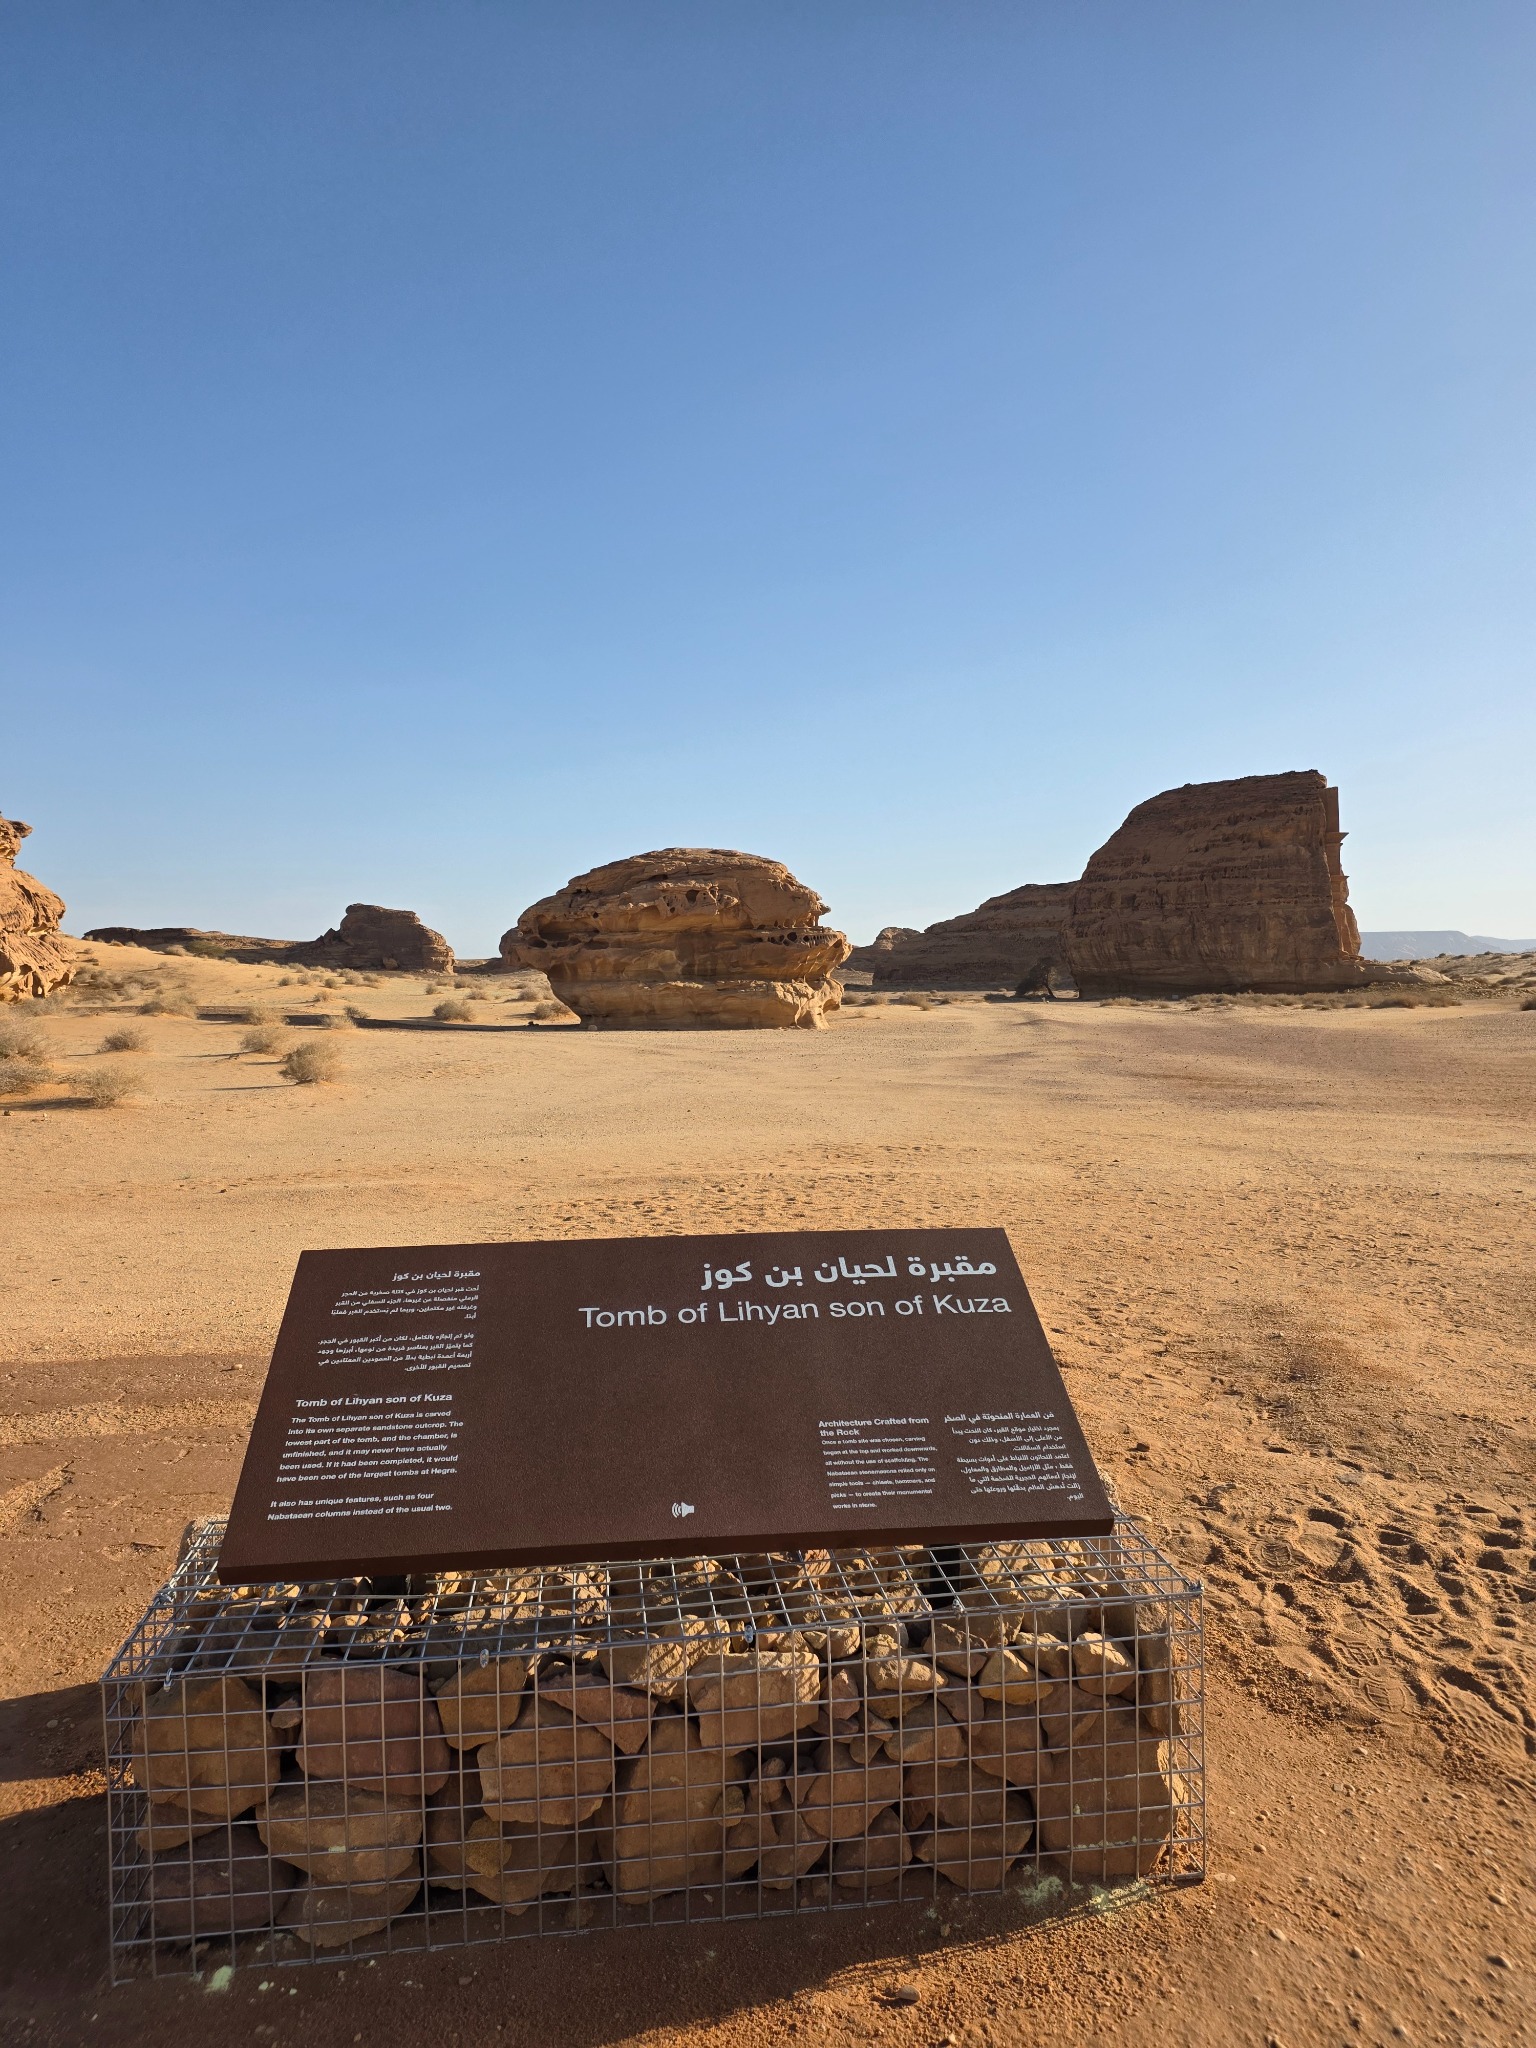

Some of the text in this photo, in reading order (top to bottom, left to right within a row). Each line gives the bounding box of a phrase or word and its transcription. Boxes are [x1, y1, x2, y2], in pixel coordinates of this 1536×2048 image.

[392, 1270, 481, 1281] مقبرة لحيان بن كوز
[701, 1255, 997, 1290] مقبرة لحيان بن كوز
[578, 1294, 1012, 1328] Tomb of Lihyan son of Kuza
[296, 1398, 327, 1407] Tomb
[330, 1397, 343, 1406] of
[345, 1397, 383, 1406] Lihyan
[409, 1394, 422, 1402] of
[424, 1393, 452, 1401] Kuza
[819, 1419, 872, 1427] Architecture
[874, 1417, 907, 1425] Crafted
[944, 1411, 1054, 1424] فن العمارة المنحوتة في الصخر
[336, 1425, 371, 1433] separate
[836, 1428, 860, 1436] Rock
[314, 1438, 330, 1446] part
[363, 1470, 392, 1478] largest
[315, 1510, 351, 1518] columns
[352, 1507, 384, 1515] instead
[411, 1504, 434, 1512] usual
